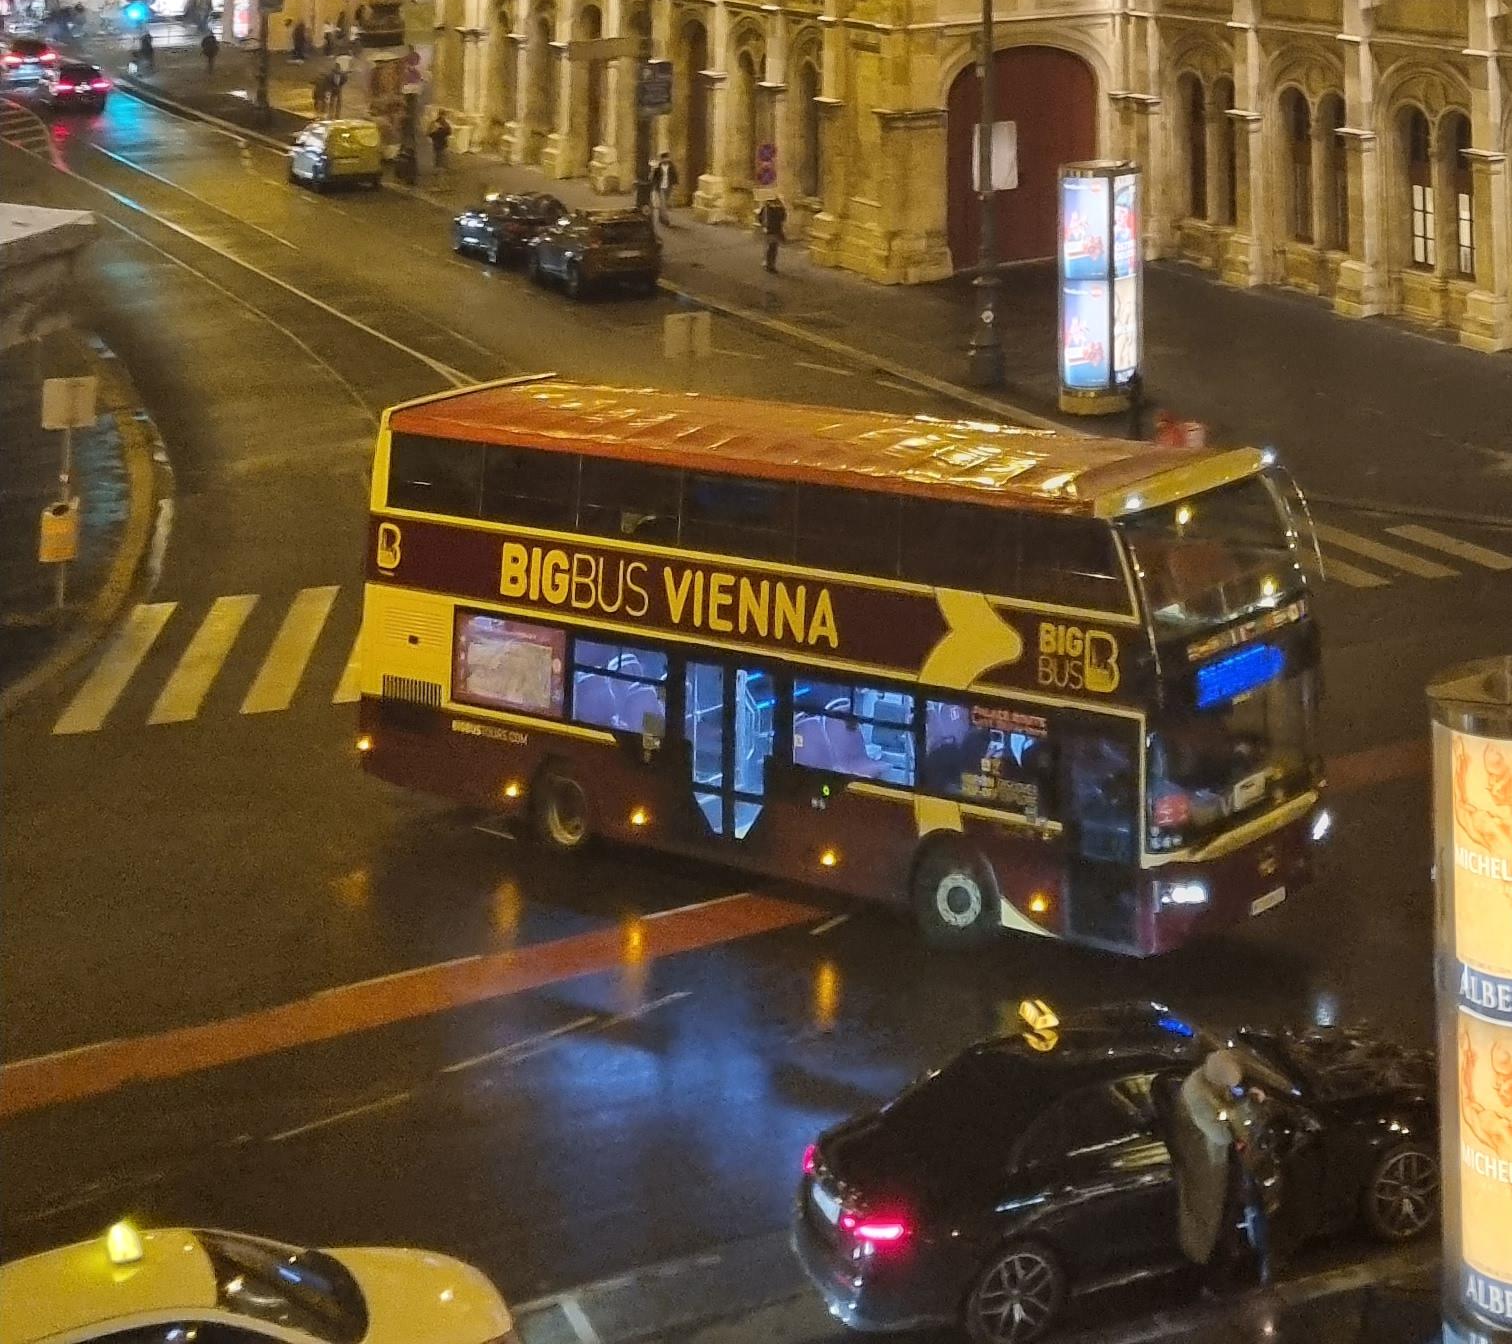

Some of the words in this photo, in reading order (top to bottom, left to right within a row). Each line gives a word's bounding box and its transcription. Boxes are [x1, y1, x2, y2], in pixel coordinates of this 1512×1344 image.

[663, 566, 839, 649] VIENNA
[1040, 622, 1083, 657] BIG
[1038, 655, 1083, 690] BUS
